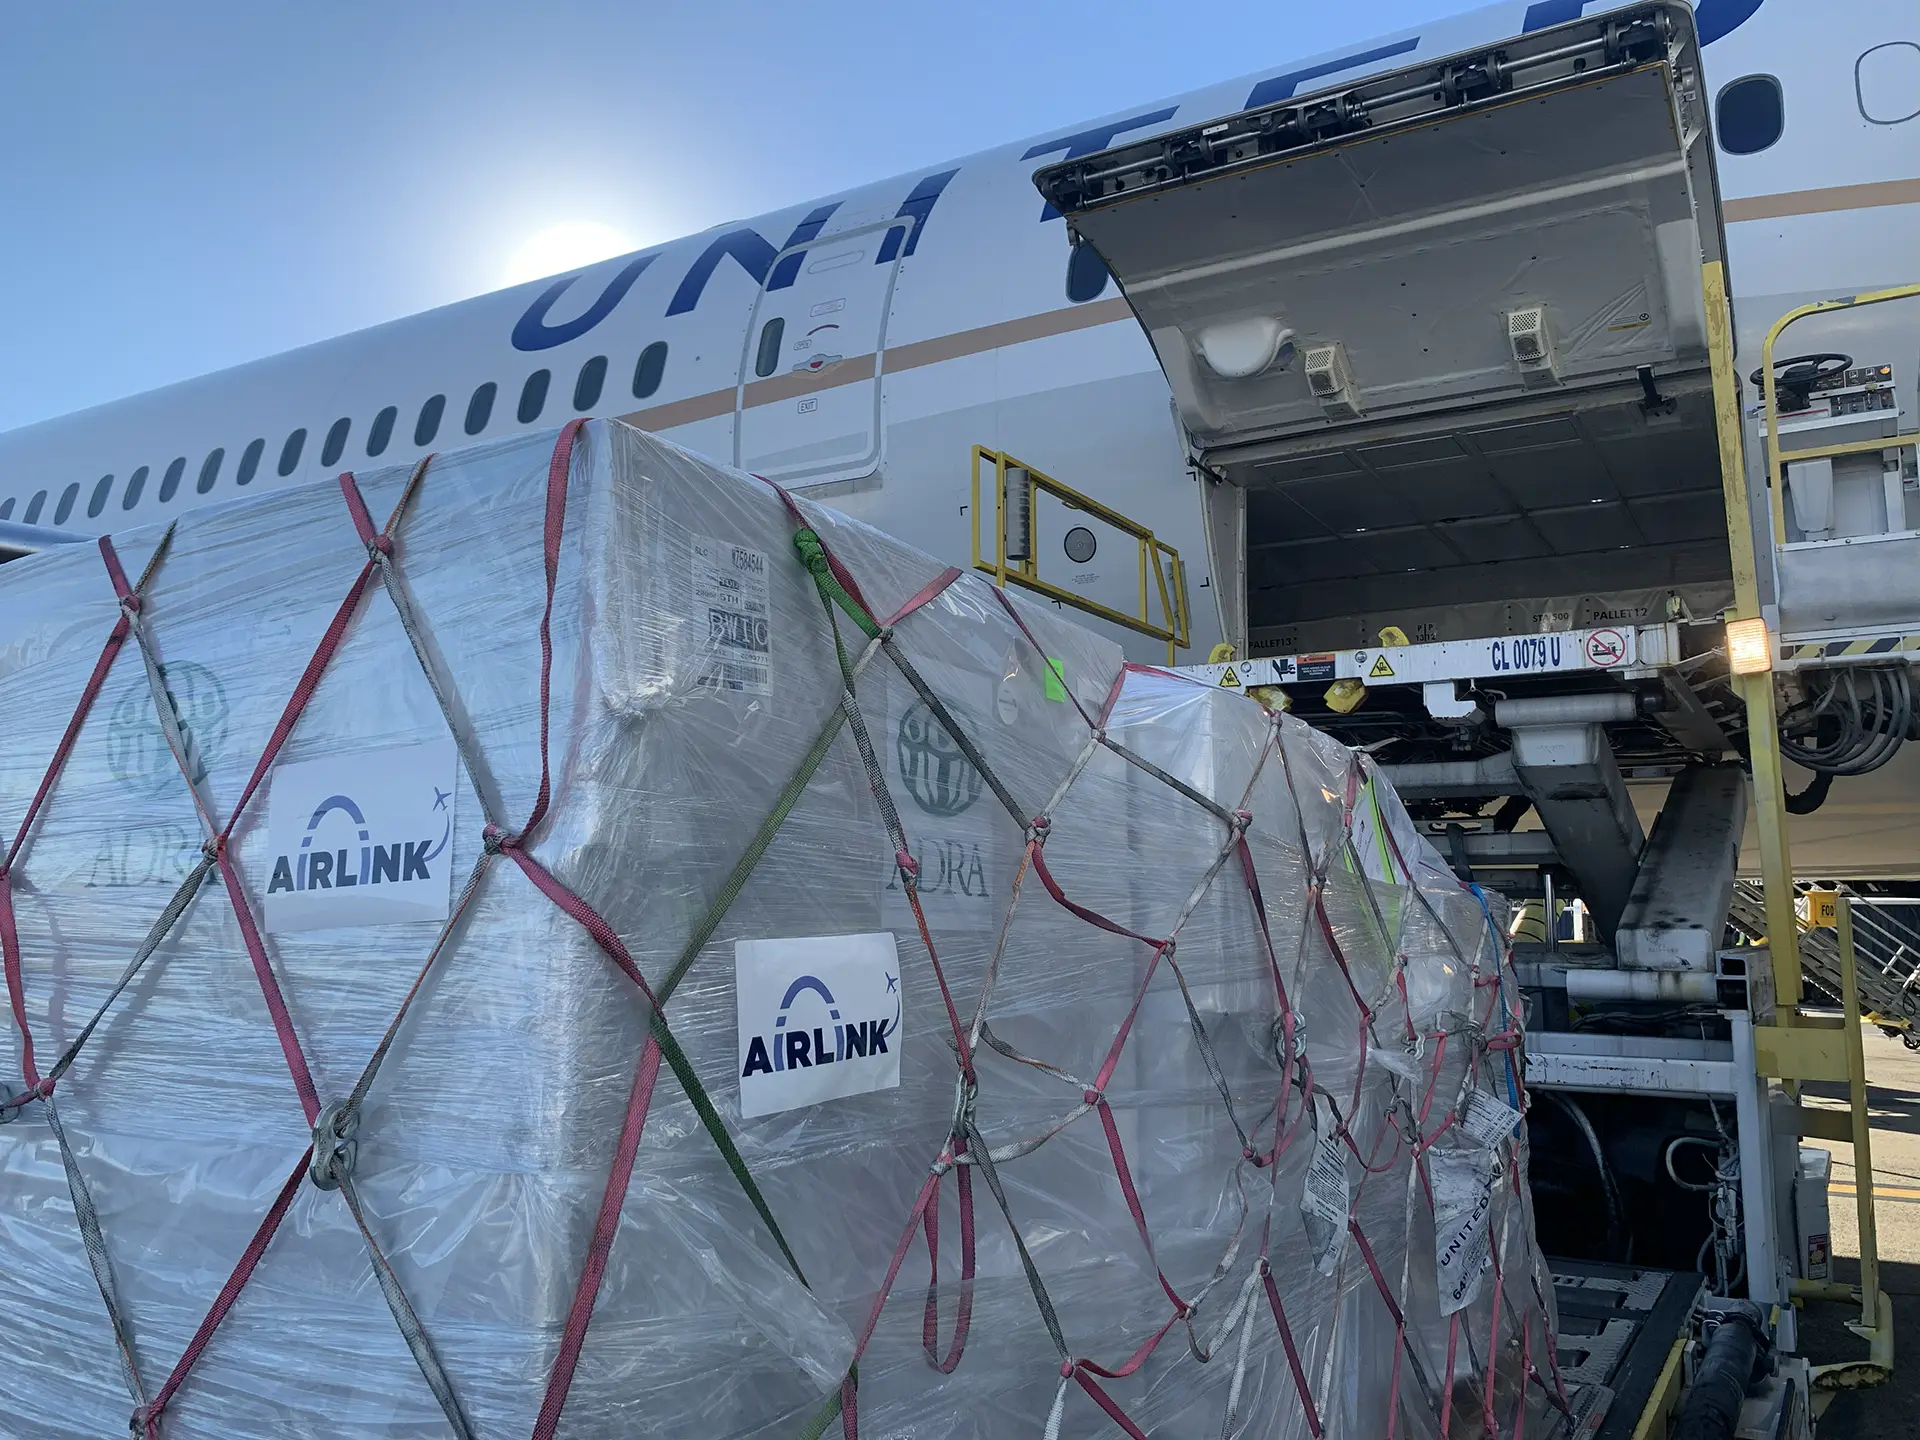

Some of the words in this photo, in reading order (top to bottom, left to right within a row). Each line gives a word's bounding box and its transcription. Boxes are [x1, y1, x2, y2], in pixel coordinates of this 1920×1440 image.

[801, 401, 814, 411] EXIT
[1553, 612, 1569, 621] 500
[1492, 641, 1509, 671] CL
[1513, 637, 1546, 669] 0079
[1551, 636, 1561, 667] U
[84, 823, 221, 888] ADR
[1822, 905, 1834, 916] FOD
[1440, 1196, 1489, 1267] UNITED
